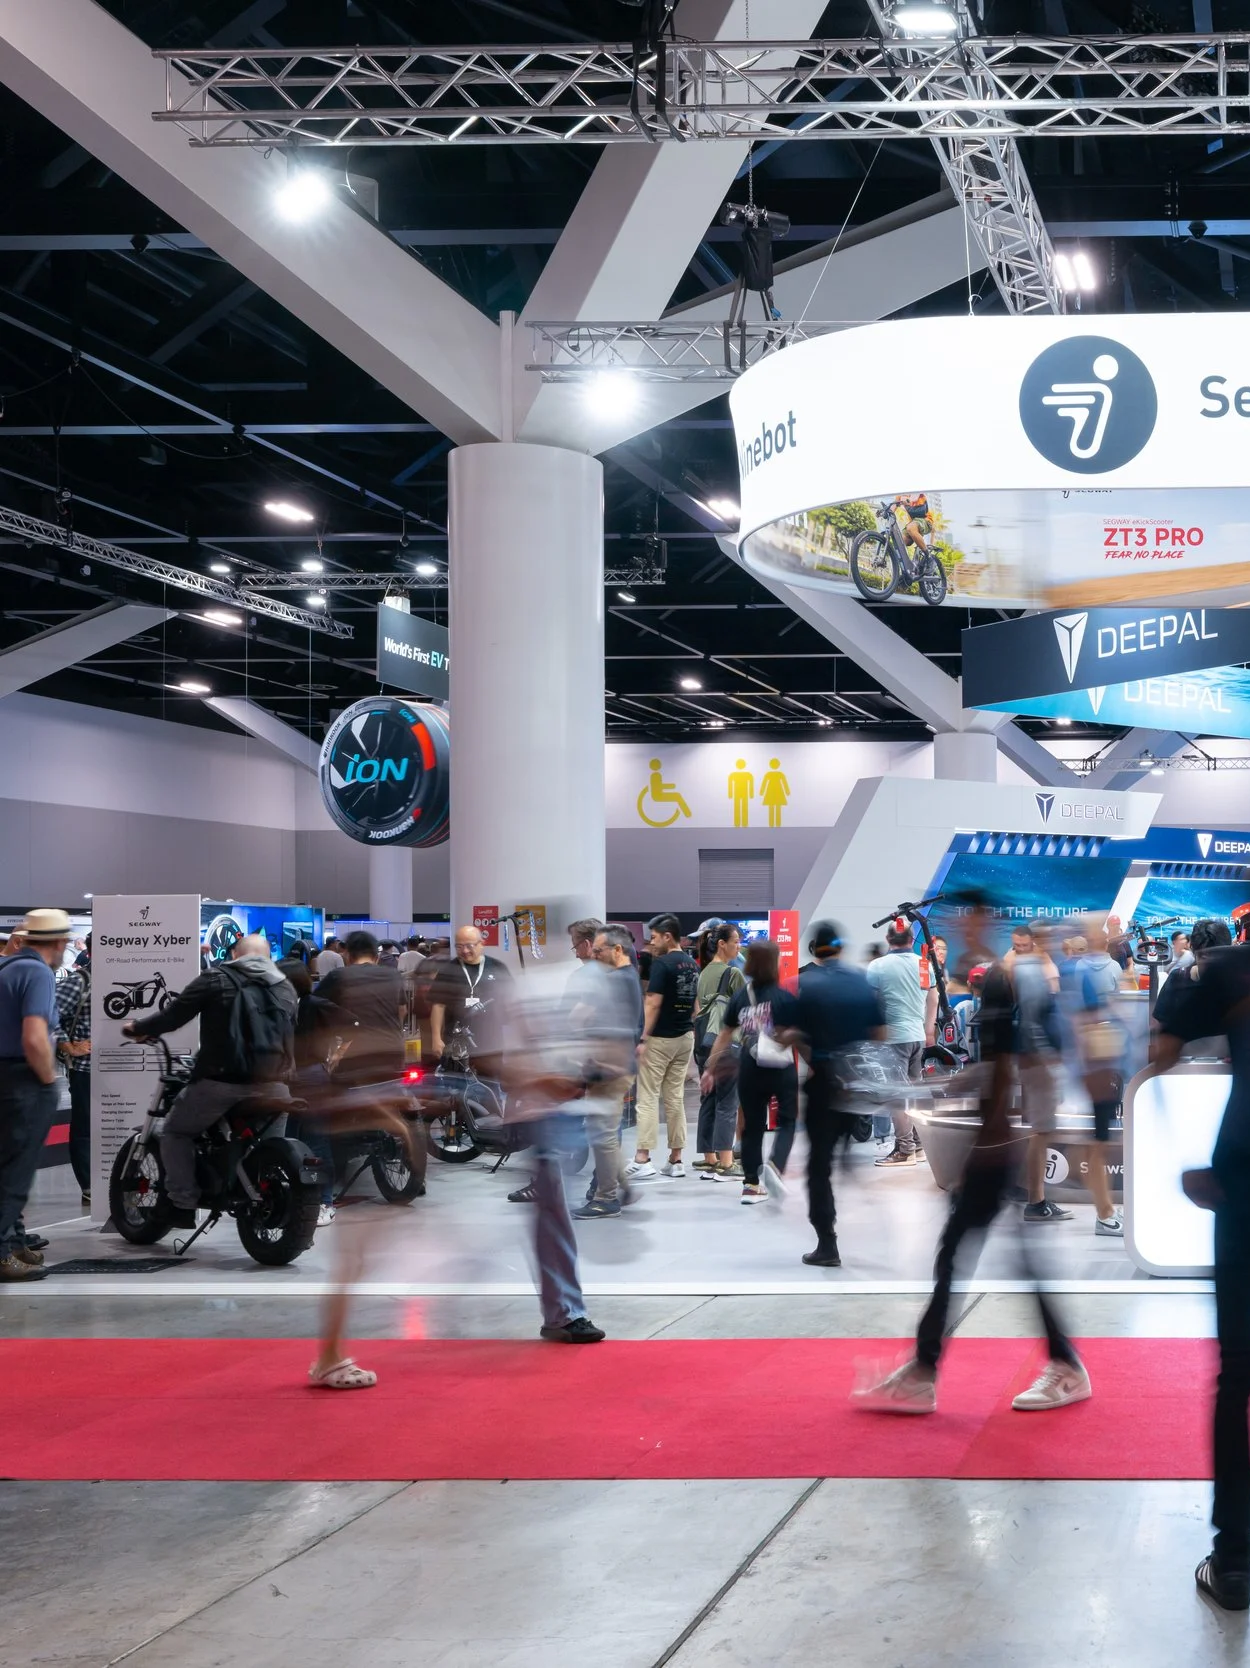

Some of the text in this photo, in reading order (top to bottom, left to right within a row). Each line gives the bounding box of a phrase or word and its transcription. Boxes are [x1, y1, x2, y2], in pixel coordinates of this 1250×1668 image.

[1103, 526, 1204, 546] ZT3 PRO
[1104, 550, 1185, 560] FEAR NO PLACE
[1097, 608, 1219, 659] DEEPAL
[384, 636, 413, 659] World's
[412, 646, 430, 665] First
[430, 650, 444, 669] EV
[1123, 680, 1232, 713] DEEPAL
[1061, 803, 1124, 820] DEEPAL
[955, 906, 1002, 917] TOCH
[1006, 906, 1033, 917] THE
[100, 934, 192, 948] Segway Xyber
